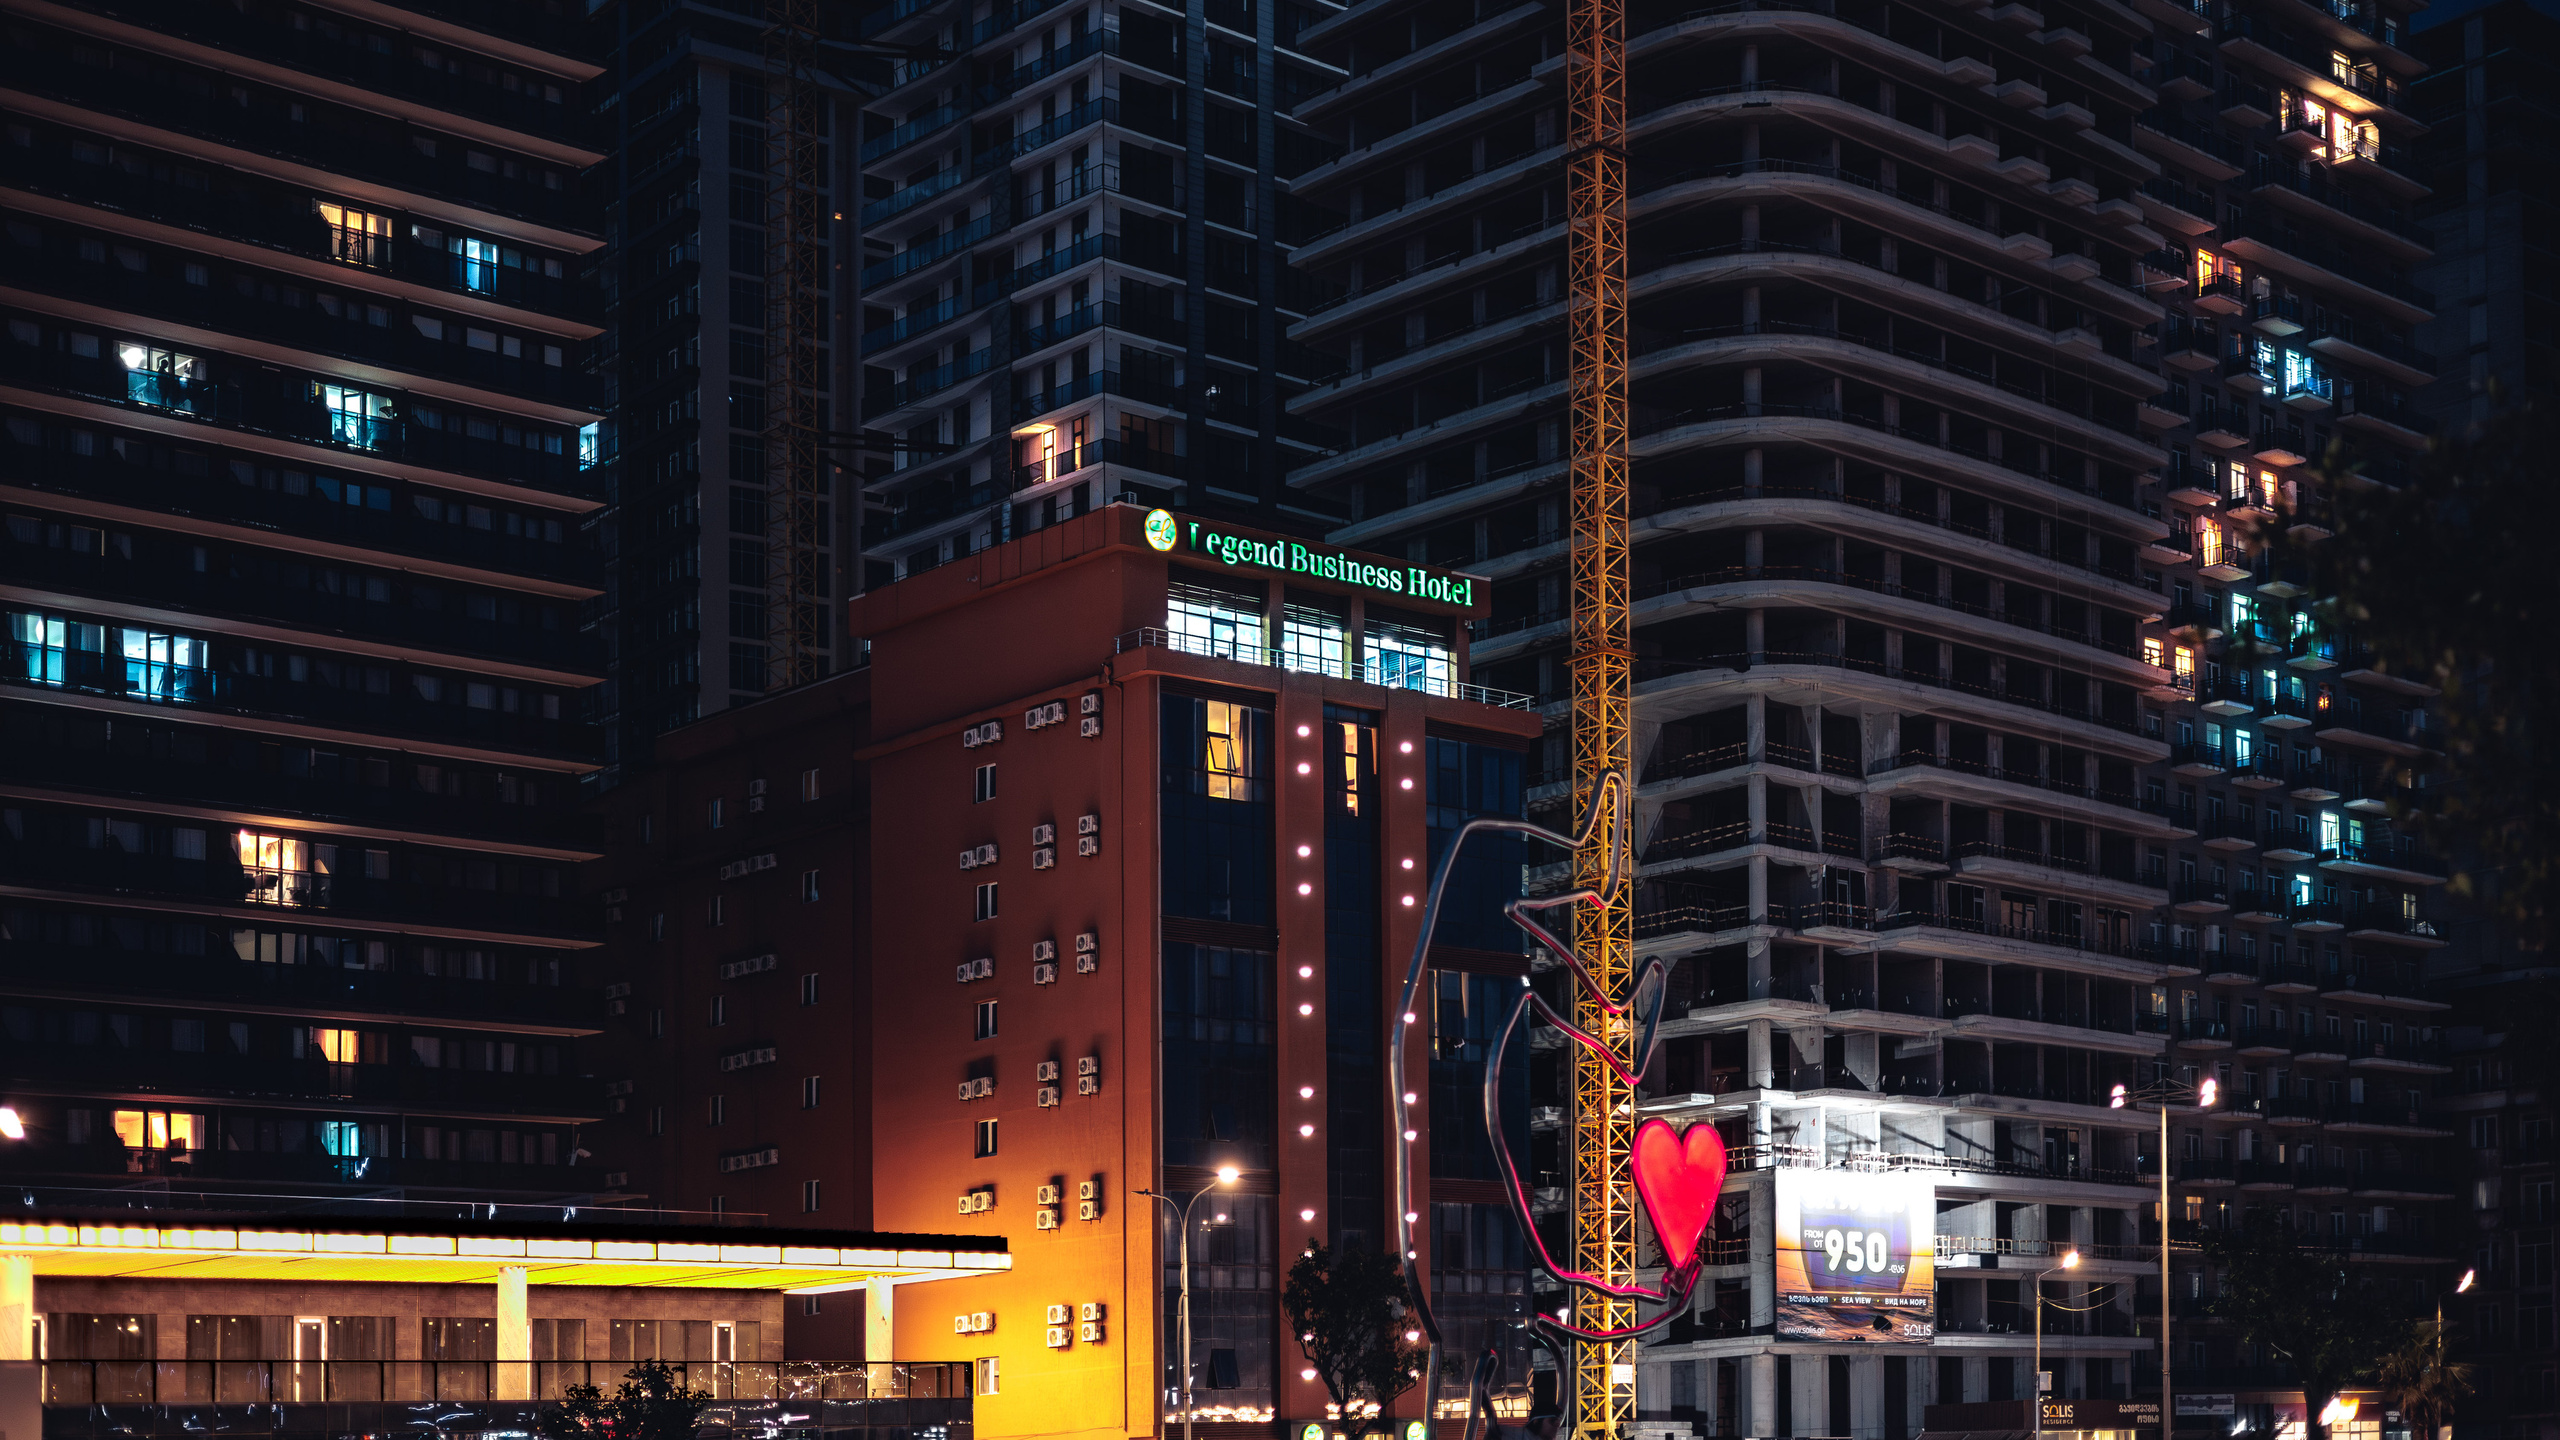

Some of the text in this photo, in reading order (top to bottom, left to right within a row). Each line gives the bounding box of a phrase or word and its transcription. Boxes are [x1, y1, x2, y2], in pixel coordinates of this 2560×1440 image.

[1290, 543, 1403, 592] Business
[1408, 567, 1473, 606] Hotel
[1804, 1229, 1824, 1239] FROM
[1825, 1229, 1887, 1273] 950
[1841, 1296, 1854, 1304] SEA
[1784, 1325, 1826, 1336] www.solis.ge
[1903, 1324, 1932, 1336] SOLIS
[2042, 1404, 2074, 1418] SOLIS
